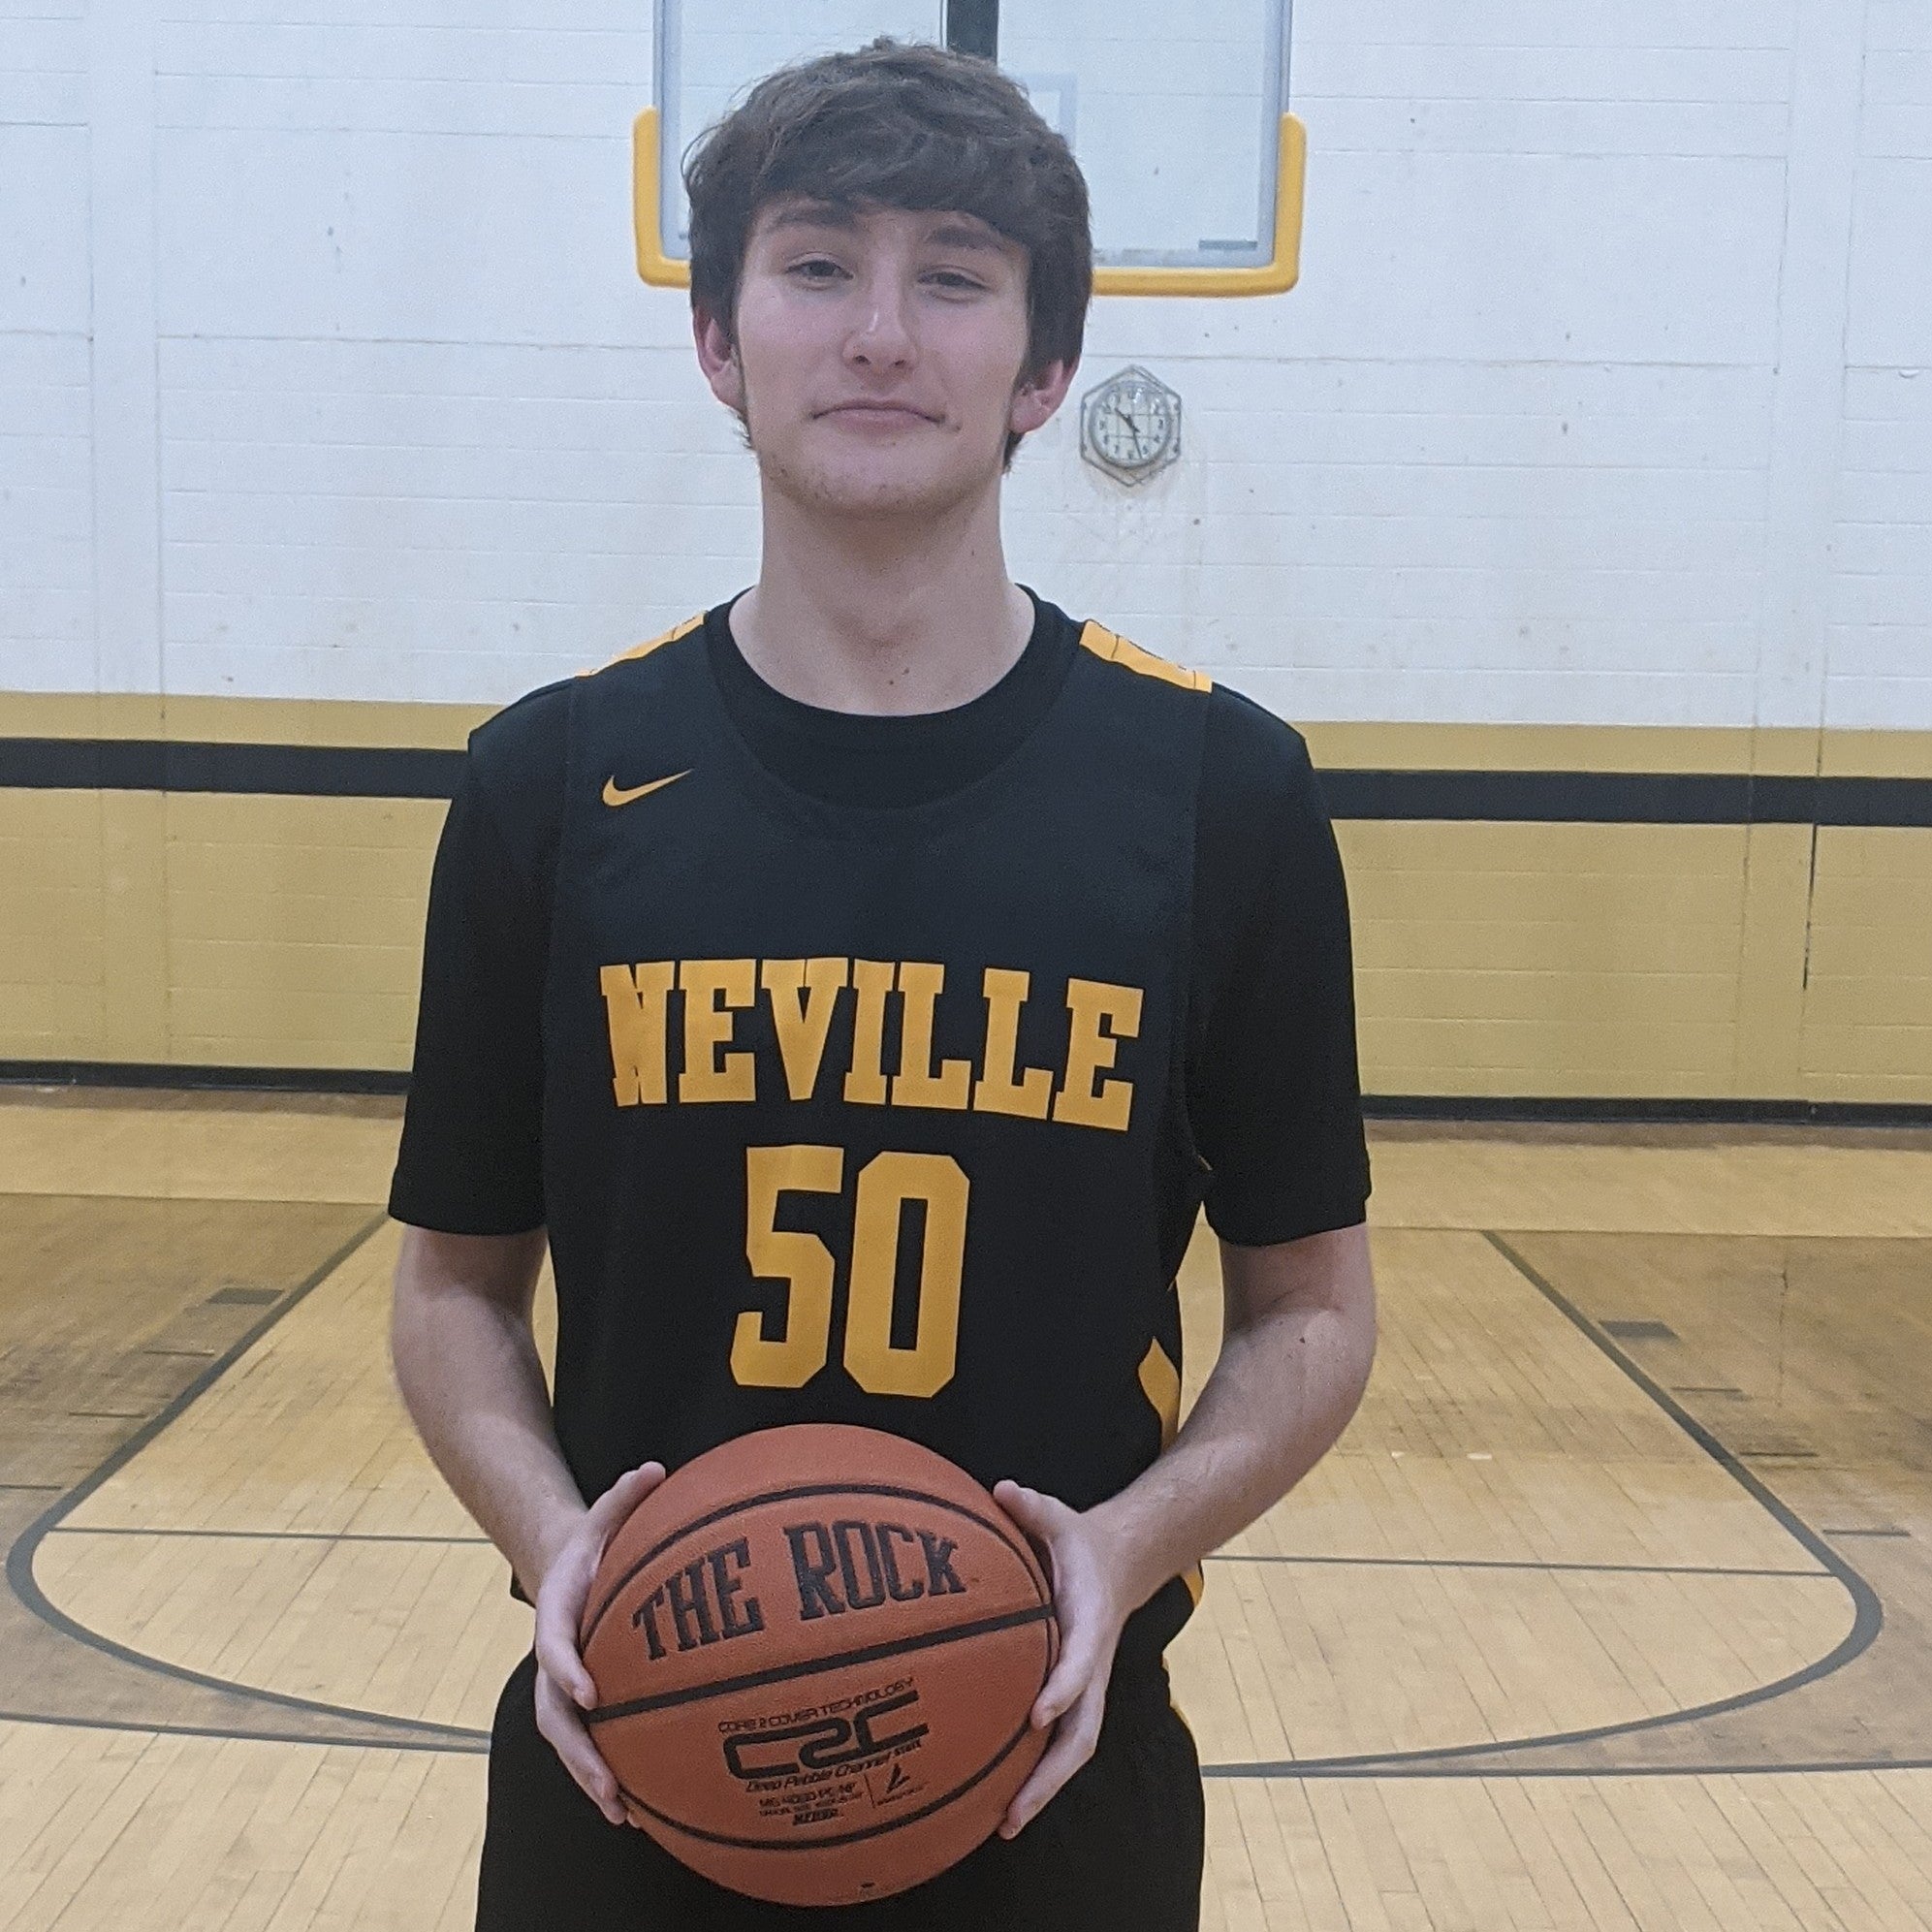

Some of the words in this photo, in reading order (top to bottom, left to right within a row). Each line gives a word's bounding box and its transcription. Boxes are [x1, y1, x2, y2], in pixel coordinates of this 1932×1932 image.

[600, 957, 1144, 1131] NEVILLE
[730, 1145, 971, 1400] 50
[632, 1536, 765, 1661] THE
[783, 1520, 966, 1621] ROCK
[769, 1708, 818, 1727] COVER
[819, 1676, 914, 1715] TECHNOLOGY
[783, 1769, 833, 1789] Pebble
[835, 1751, 891, 1778] Channel
